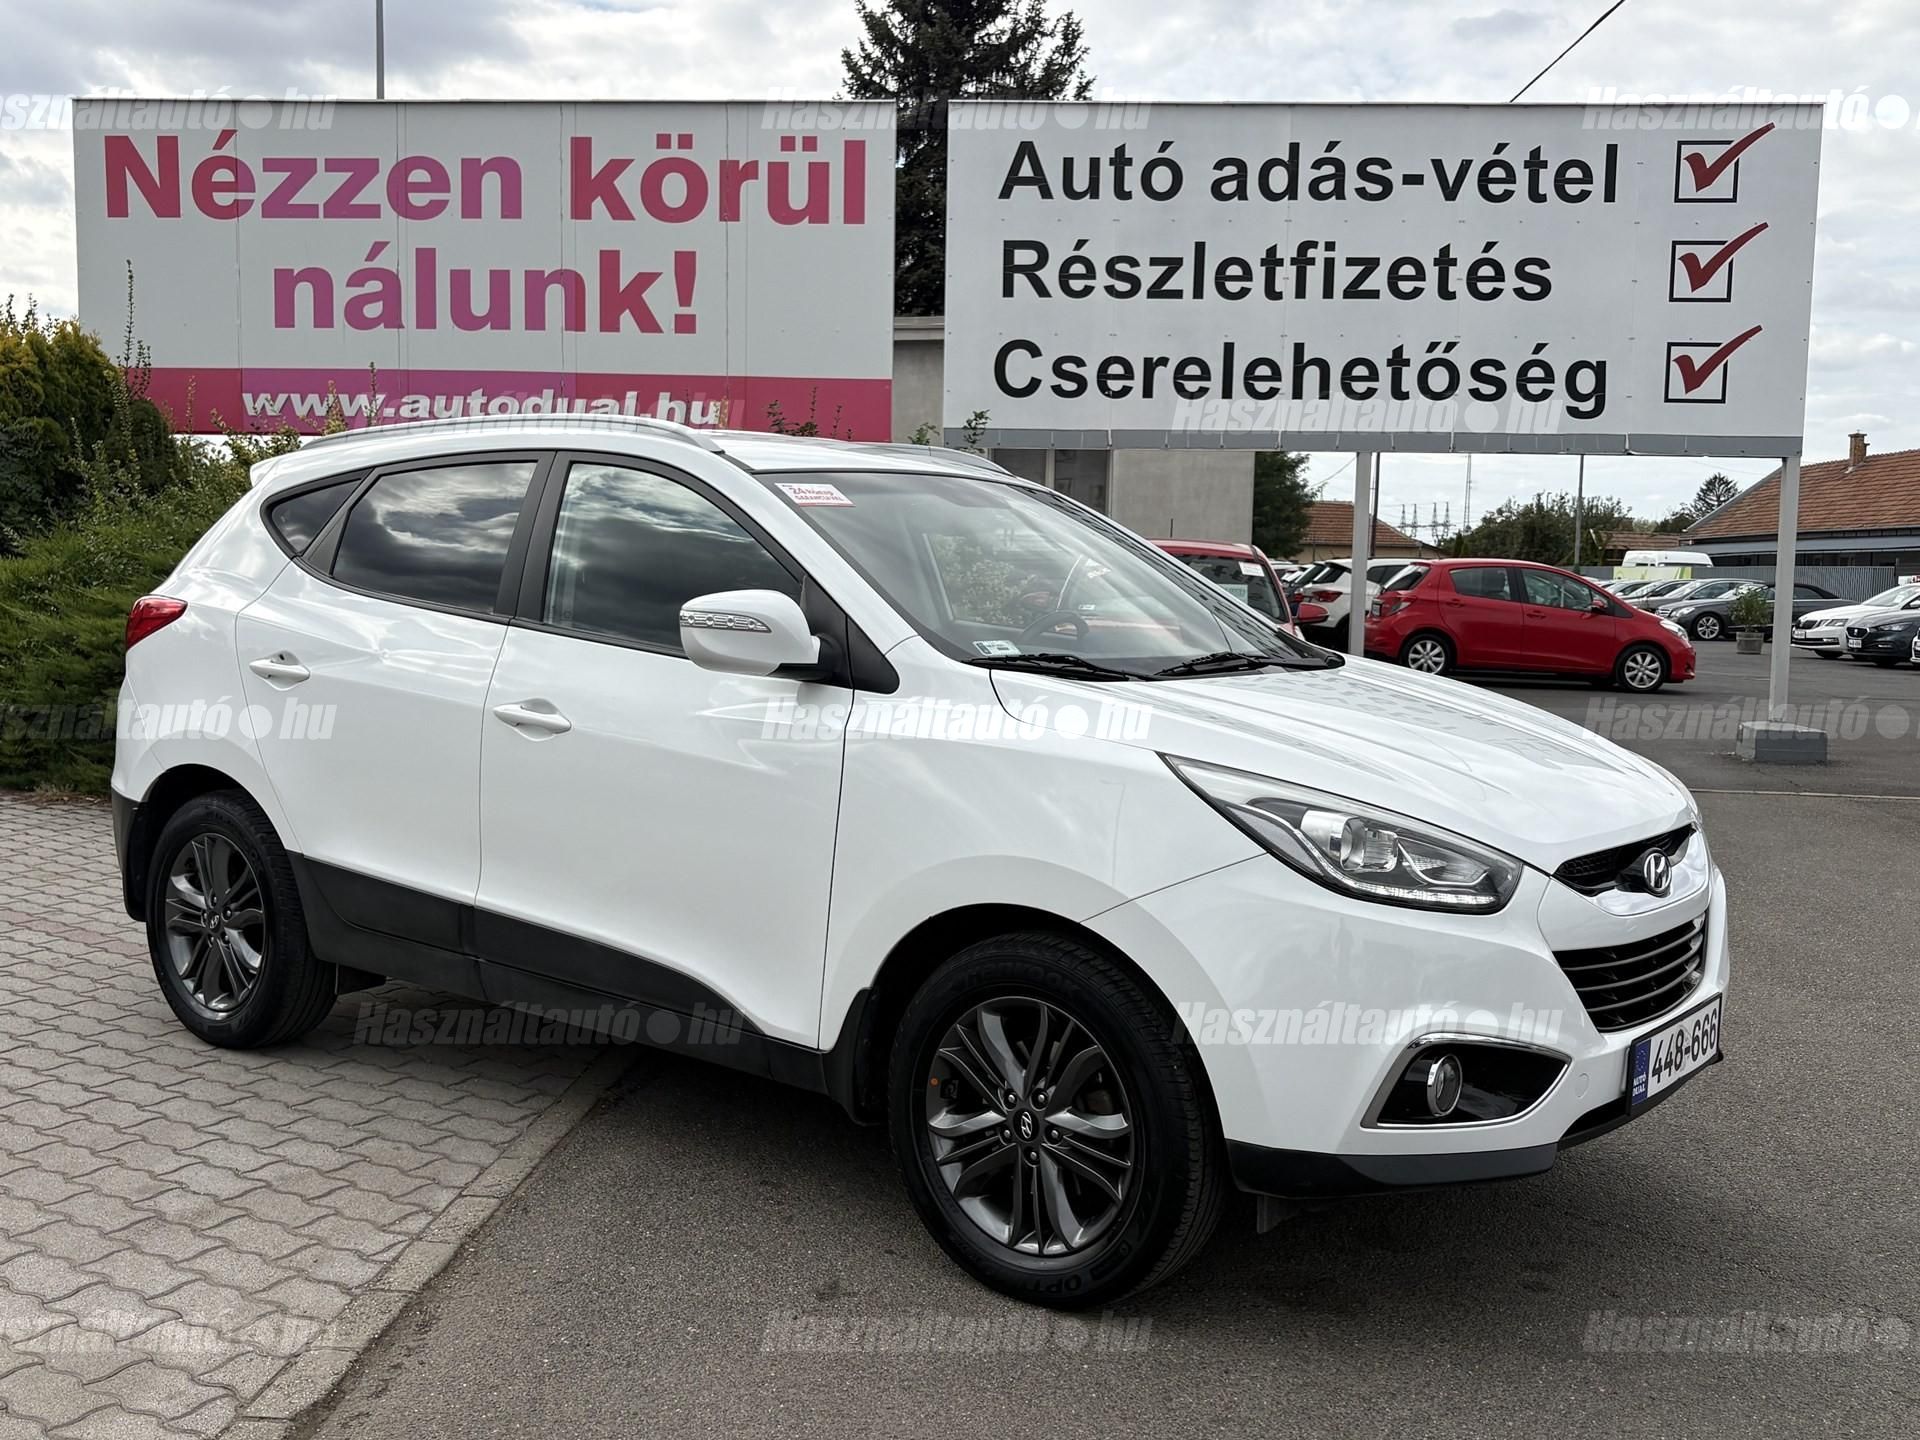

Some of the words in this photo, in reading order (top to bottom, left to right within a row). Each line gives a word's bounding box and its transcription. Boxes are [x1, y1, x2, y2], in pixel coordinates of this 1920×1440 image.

[104, 129, 521, 219] Nézzen
[570, 134, 866, 225] körül
[998, 140, 1184, 202] Autó
[1210, 140, 1618, 204] adás-vétel
[274, 240, 697, 334] nálunk!
[1002, 238, 1552, 302] Részletfizetés
[993, 339, 1607, 420] Cserelehetőség
[1651, 1007, 1718, 1084] 448-666
